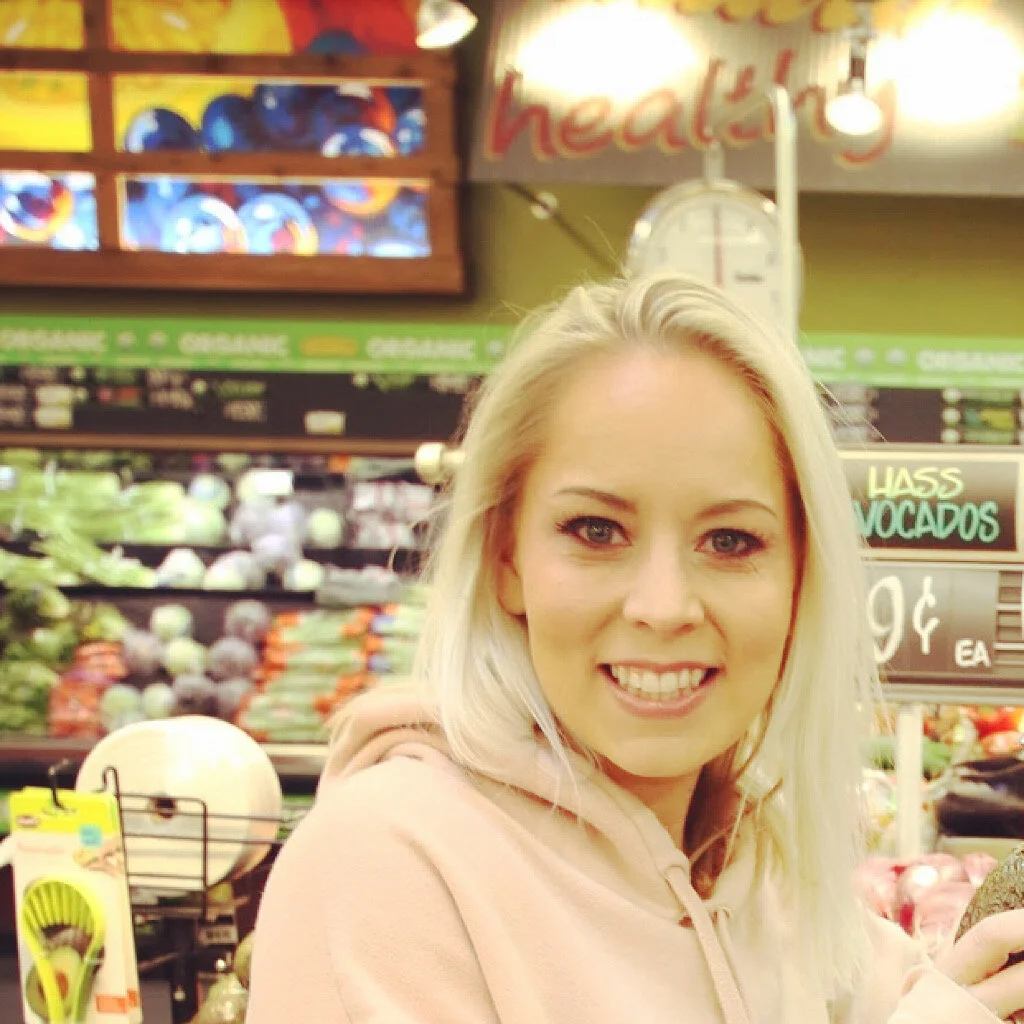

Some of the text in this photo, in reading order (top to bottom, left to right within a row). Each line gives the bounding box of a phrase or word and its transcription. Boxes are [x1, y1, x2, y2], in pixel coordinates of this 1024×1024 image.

[178, 331, 289, 357] ORGANIC
[366, 336, 477, 361] ORGANIC
[868, 465, 965, 500] HASS
[852, 499, 1001, 544] VOCADOS
[955, 638, 992, 668] EA
